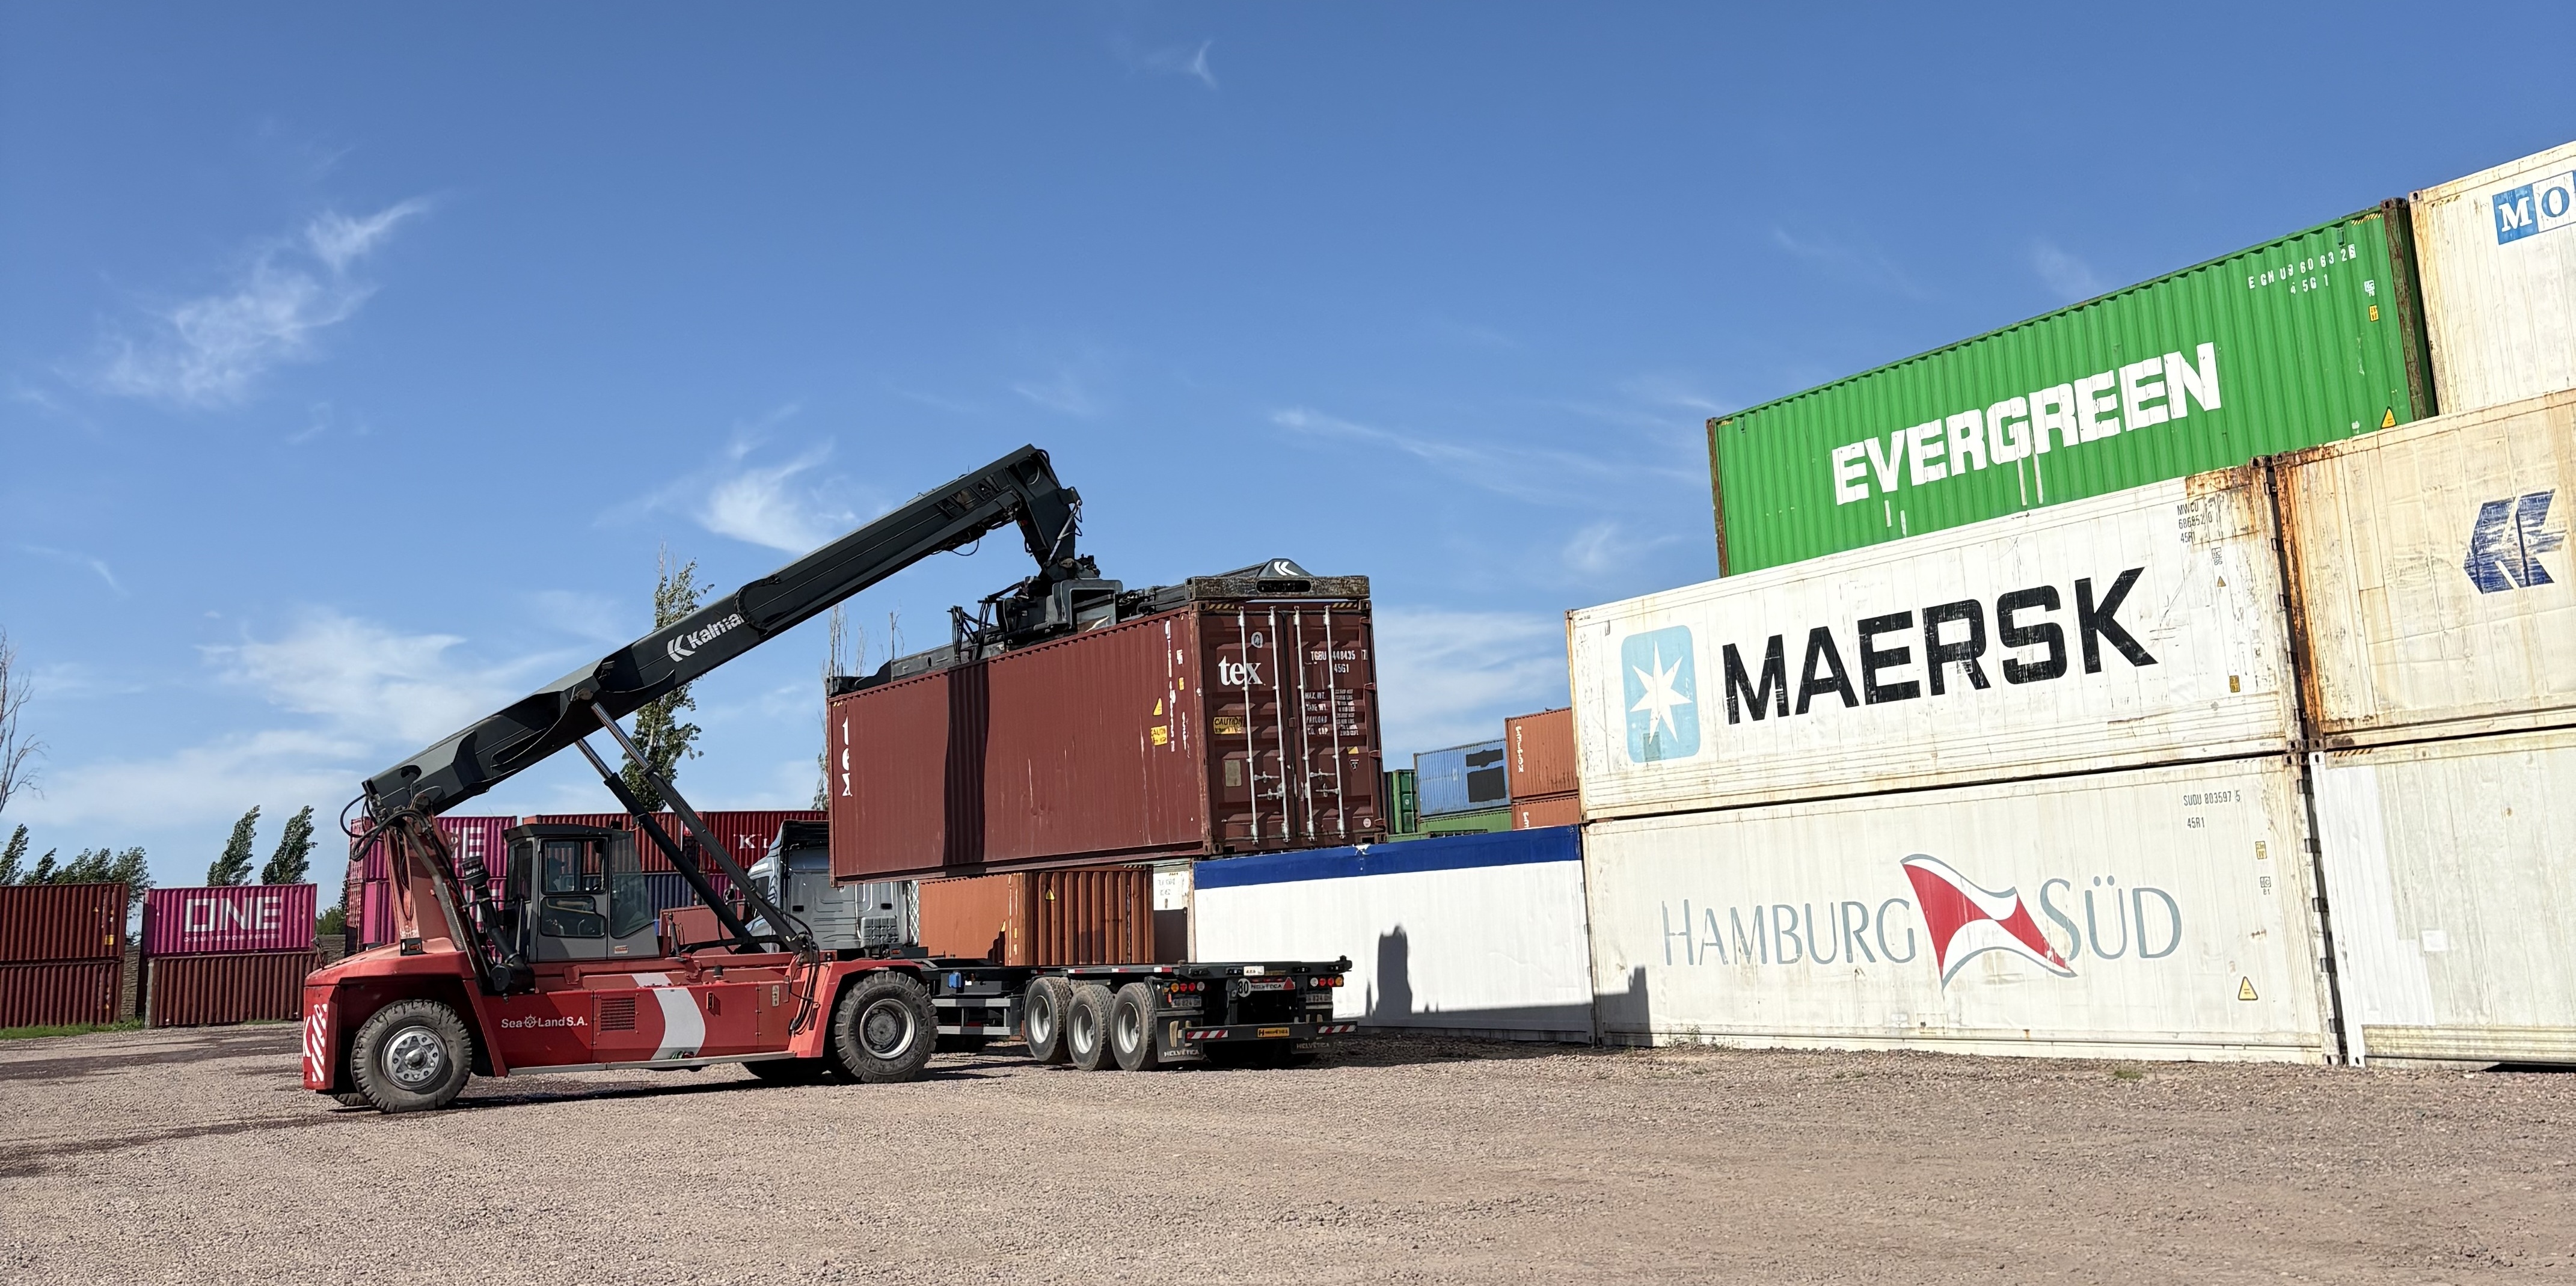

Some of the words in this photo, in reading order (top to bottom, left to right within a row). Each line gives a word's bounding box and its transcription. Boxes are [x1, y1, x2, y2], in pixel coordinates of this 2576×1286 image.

[1831, 341, 2221, 506] EVERGREEN
[686, 613, 745, 649] Kalma
[1722, 566, 2159, 726] MAERSK
[1218, 655, 1263, 686] tex
[2183, 793, 2202, 806] SUDU
[2204, 791, 2231, 804] 803597
[2187, 816, 2205, 829] 45R1
[184, 896, 281, 932] ONE
[1661, 898, 1916, 966] HAMBURG
[2038, 875, 2183, 963] SÜD
[1237, 981, 1249, 994] 80
[501, 1018, 523, 1028] Sea
[538, 1017, 565, 1027] Land
[566, 1016, 588, 1026] S.A.
